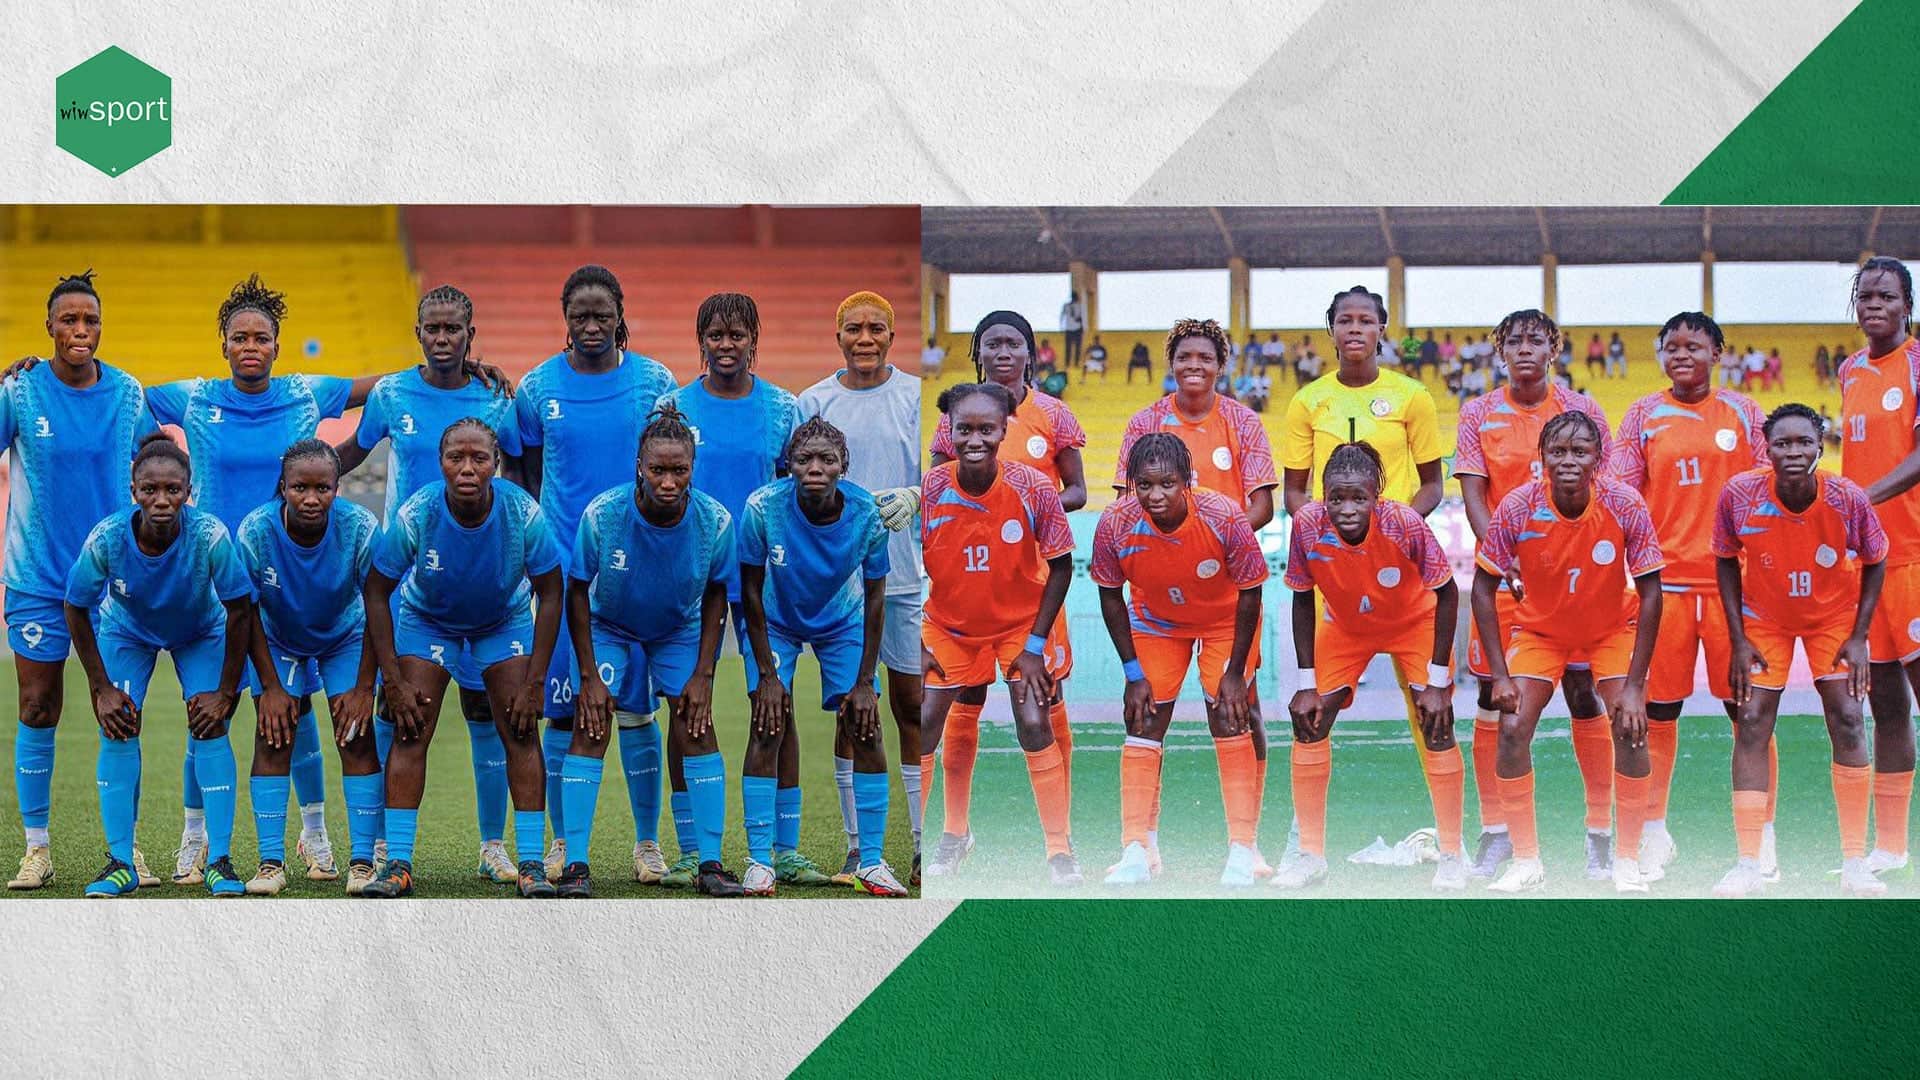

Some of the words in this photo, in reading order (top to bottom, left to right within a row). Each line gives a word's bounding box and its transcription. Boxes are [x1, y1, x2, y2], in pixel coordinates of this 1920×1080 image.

[1675, 456, 1703, 487] 11
[962, 544, 990, 572] 12
[1567, 567, 1581, 594] 7
[1787, 571, 1812, 598] 19
[1167, 586, 1185, 605] 8
[21, 622, 44, 649] 9
[430, 644, 445, 667] 3
[281, 656, 299, 687] 7
[550, 677, 573, 704] 26
